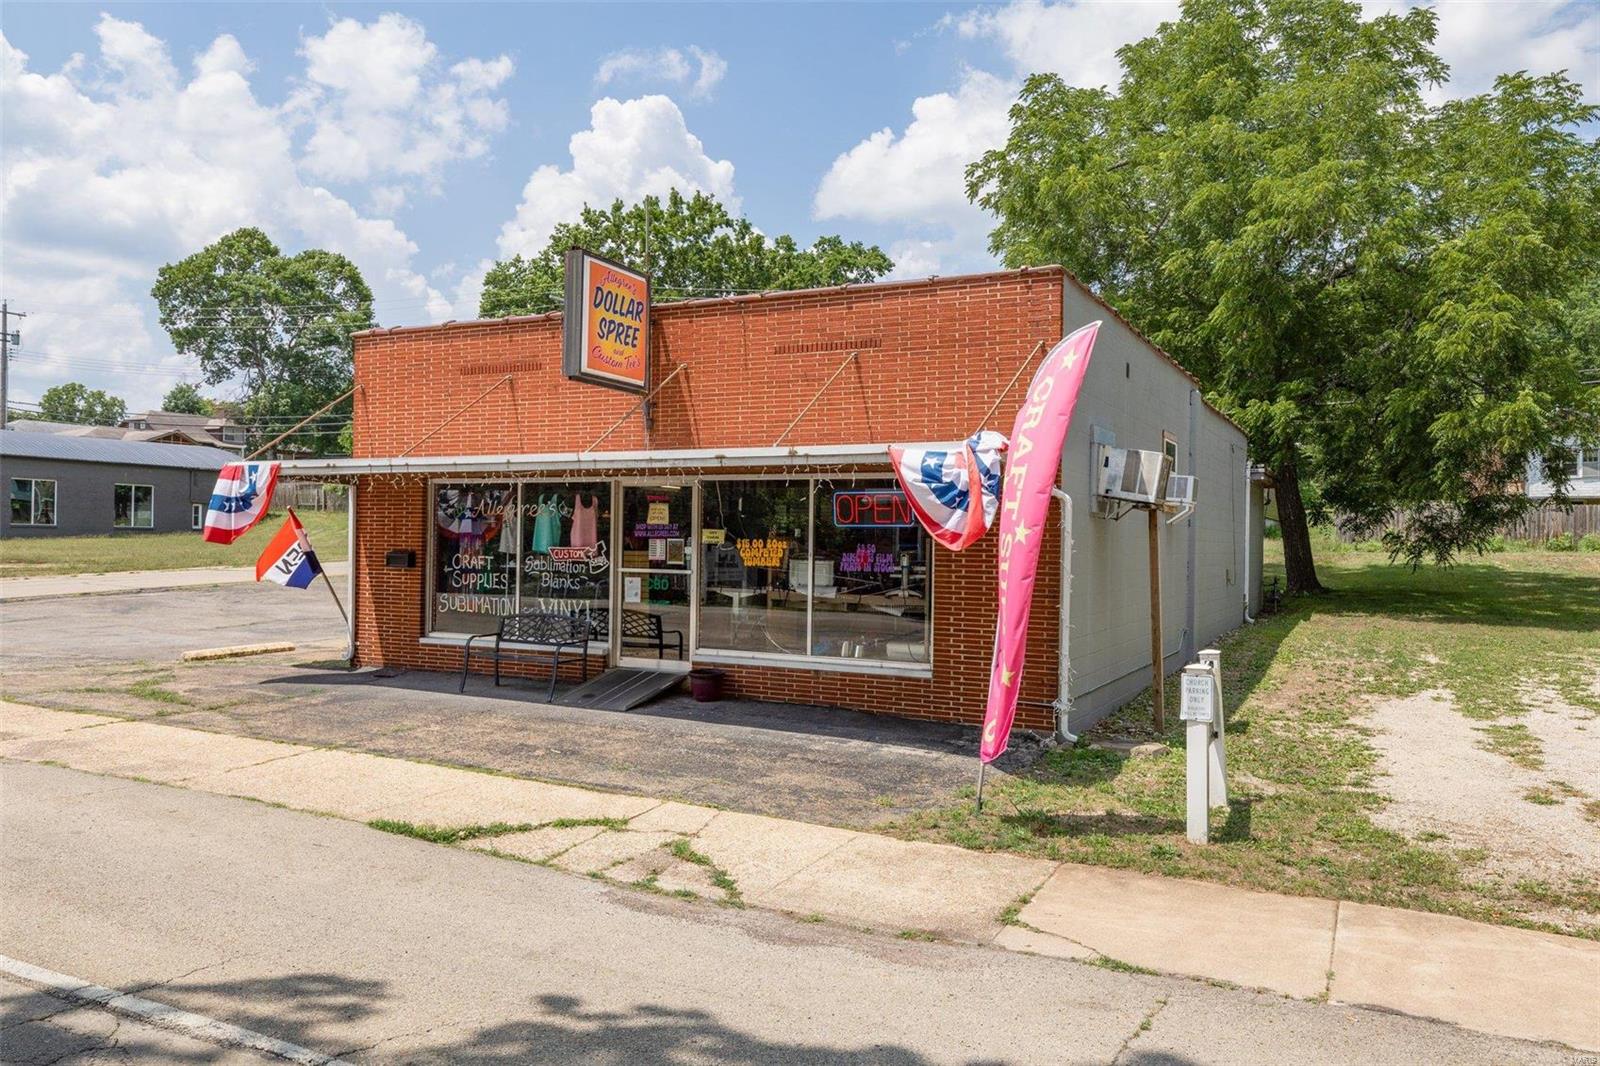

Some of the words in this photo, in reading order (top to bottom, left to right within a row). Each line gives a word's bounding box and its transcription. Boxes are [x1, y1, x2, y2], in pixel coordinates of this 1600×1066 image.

[593, 286, 644, 323] DOLLAR
[597, 317, 640, 348] SPREE
[592, 345, 623, 368] Custom
[1004, 375, 1054, 521] CRAFT
[836, 494, 911, 524] OPEN
[452, 554, 494, 570] CRAFT
[553, 549, 584, 559] CUSTOM
[452, 571, 508, 590] SUPPLIES
[541, 572, 580, 589] Blanks
[438, 593, 515, 616] SUBLIMATION
[1185, 678, 1209, 686] CHURCH
[1185, 687, 1209, 695] PARKING
